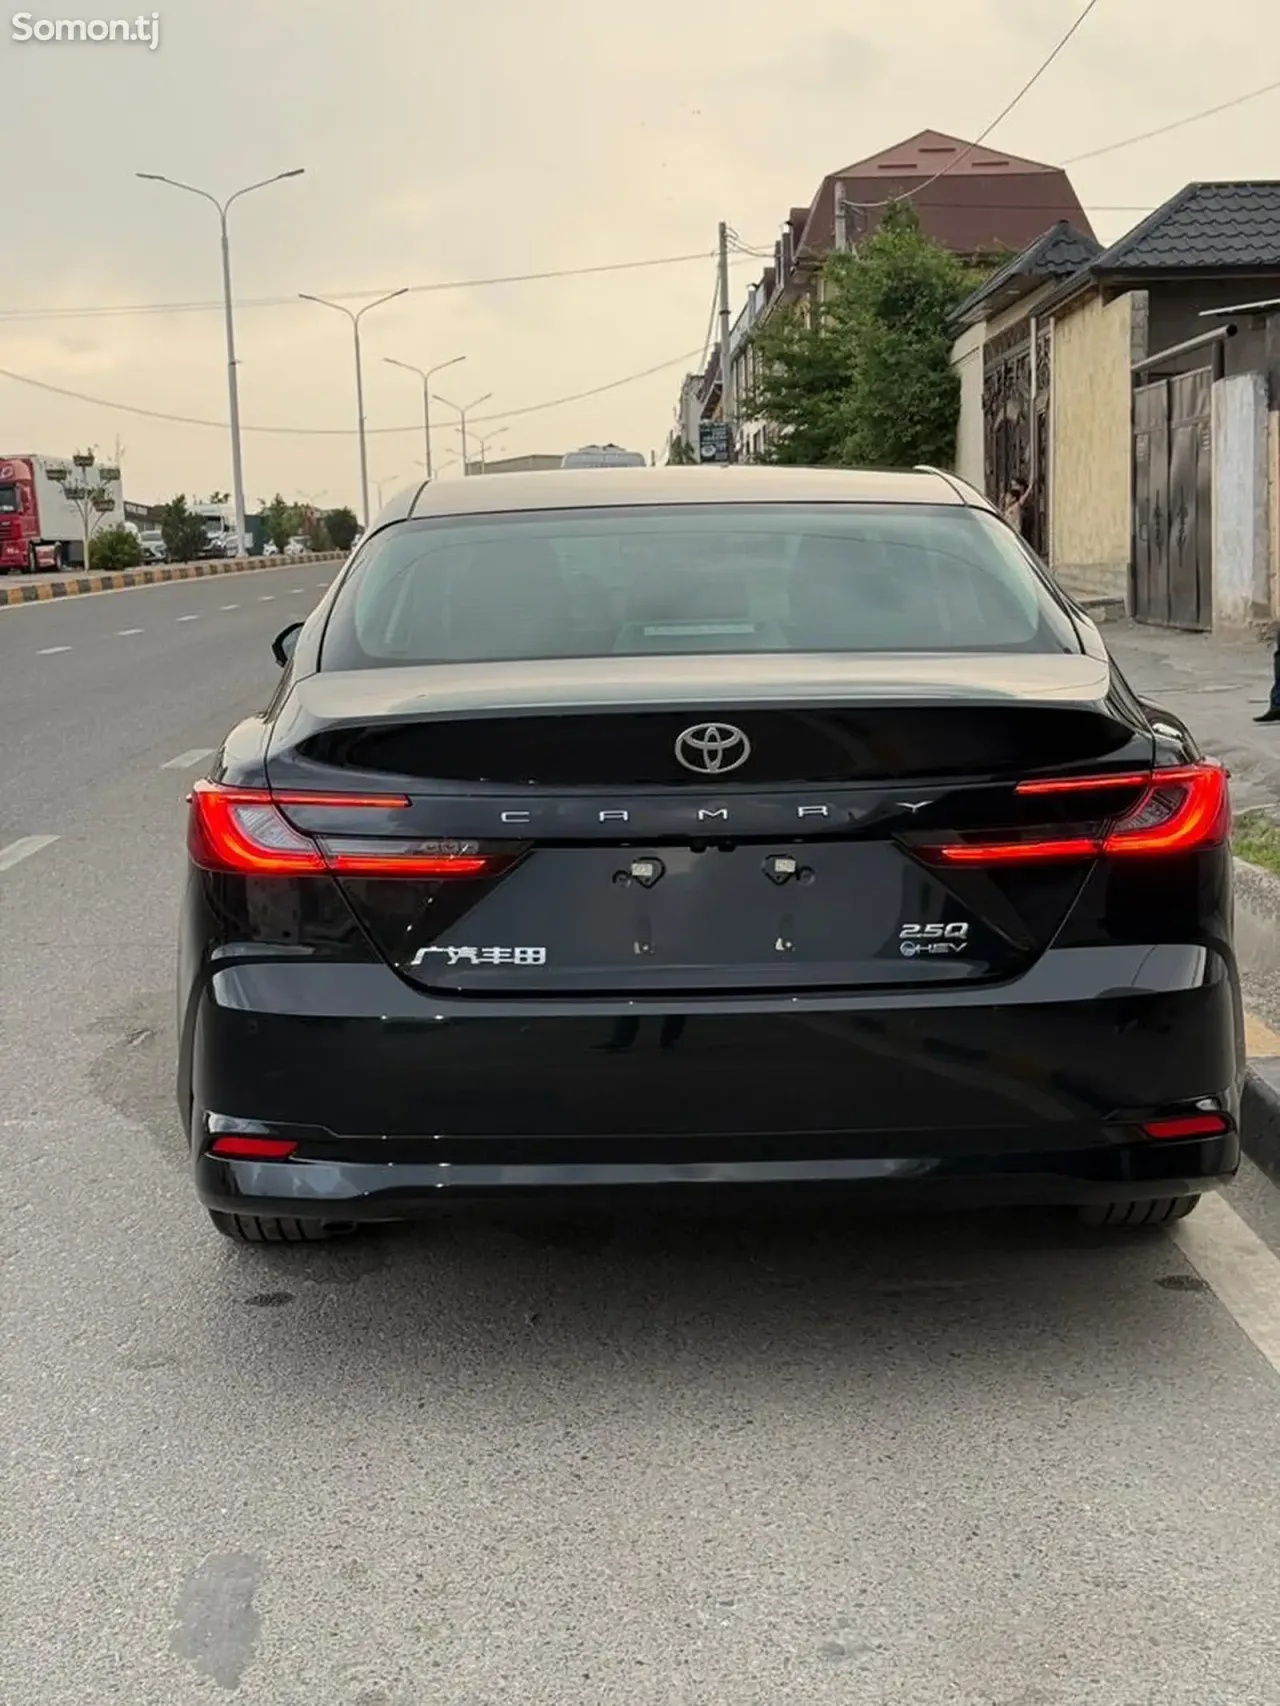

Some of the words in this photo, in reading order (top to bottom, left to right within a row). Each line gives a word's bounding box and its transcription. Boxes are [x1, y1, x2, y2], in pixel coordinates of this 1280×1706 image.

[500, 800, 933, 823] CAMRY
[410, 945, 547, 966] 广汽丰田
